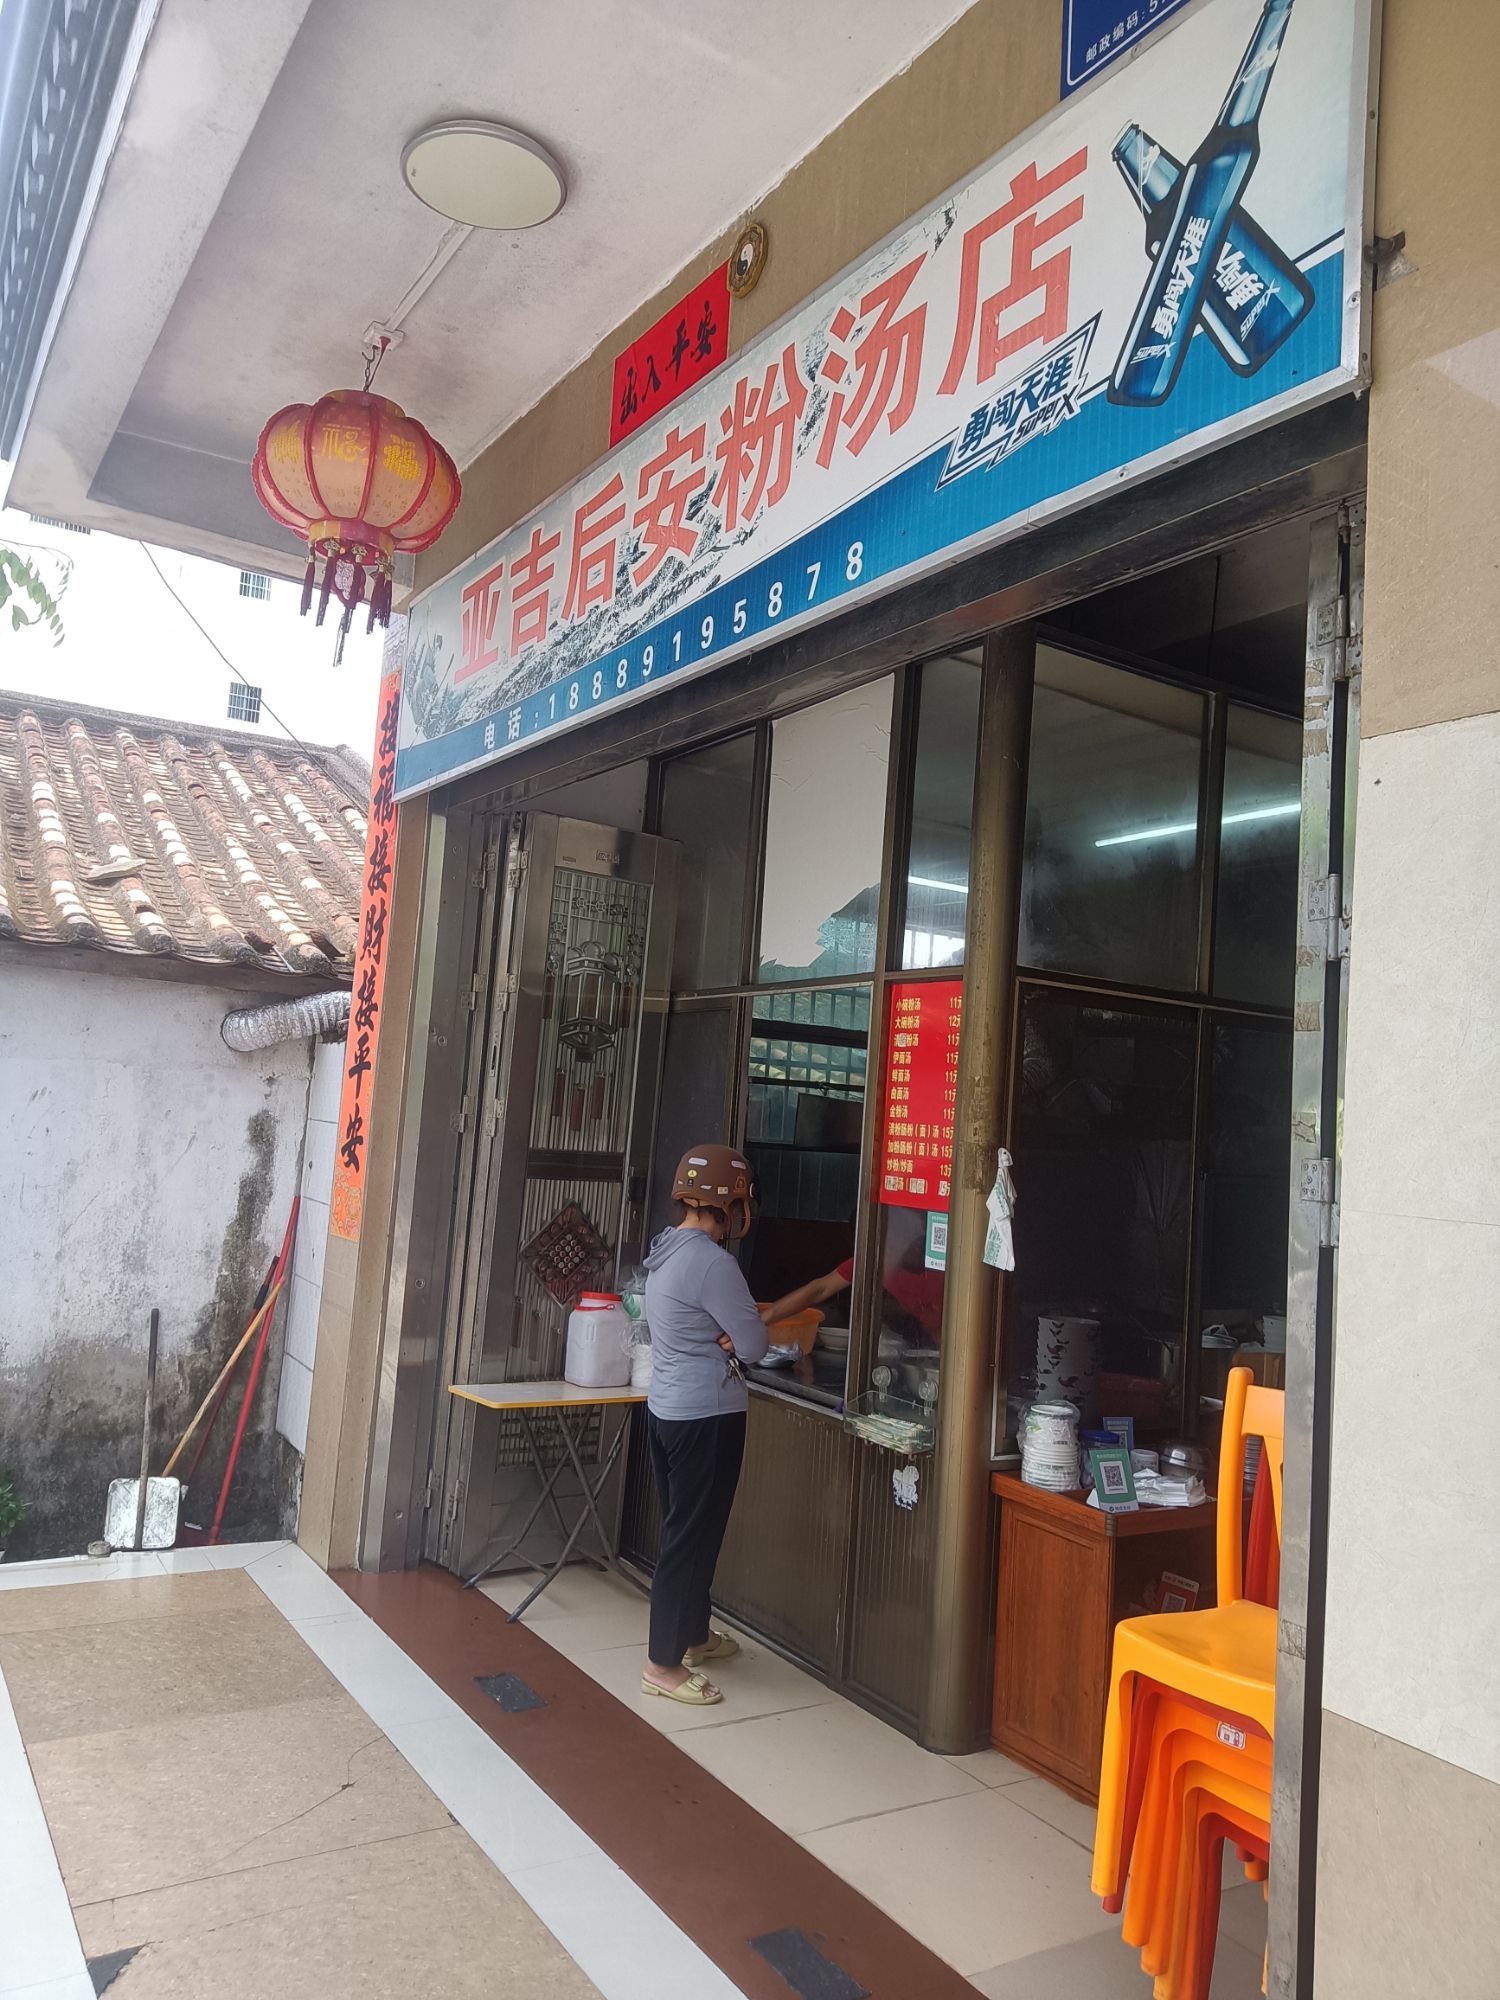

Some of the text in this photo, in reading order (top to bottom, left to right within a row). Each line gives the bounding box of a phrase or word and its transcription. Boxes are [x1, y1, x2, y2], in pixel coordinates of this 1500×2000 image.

[1151, 215, 1211, 340] 勇闯天涯
[453, 146, 1088, 684] 亚吉后安粉汤店
[620, 300, 717, 425] 出入平安
[958, 347, 1077, 459] 勇闯天涯
[895, 1016, 920, 1029] 大碗粉汤
[896, 998, 920, 1011] 小碗粉汤
